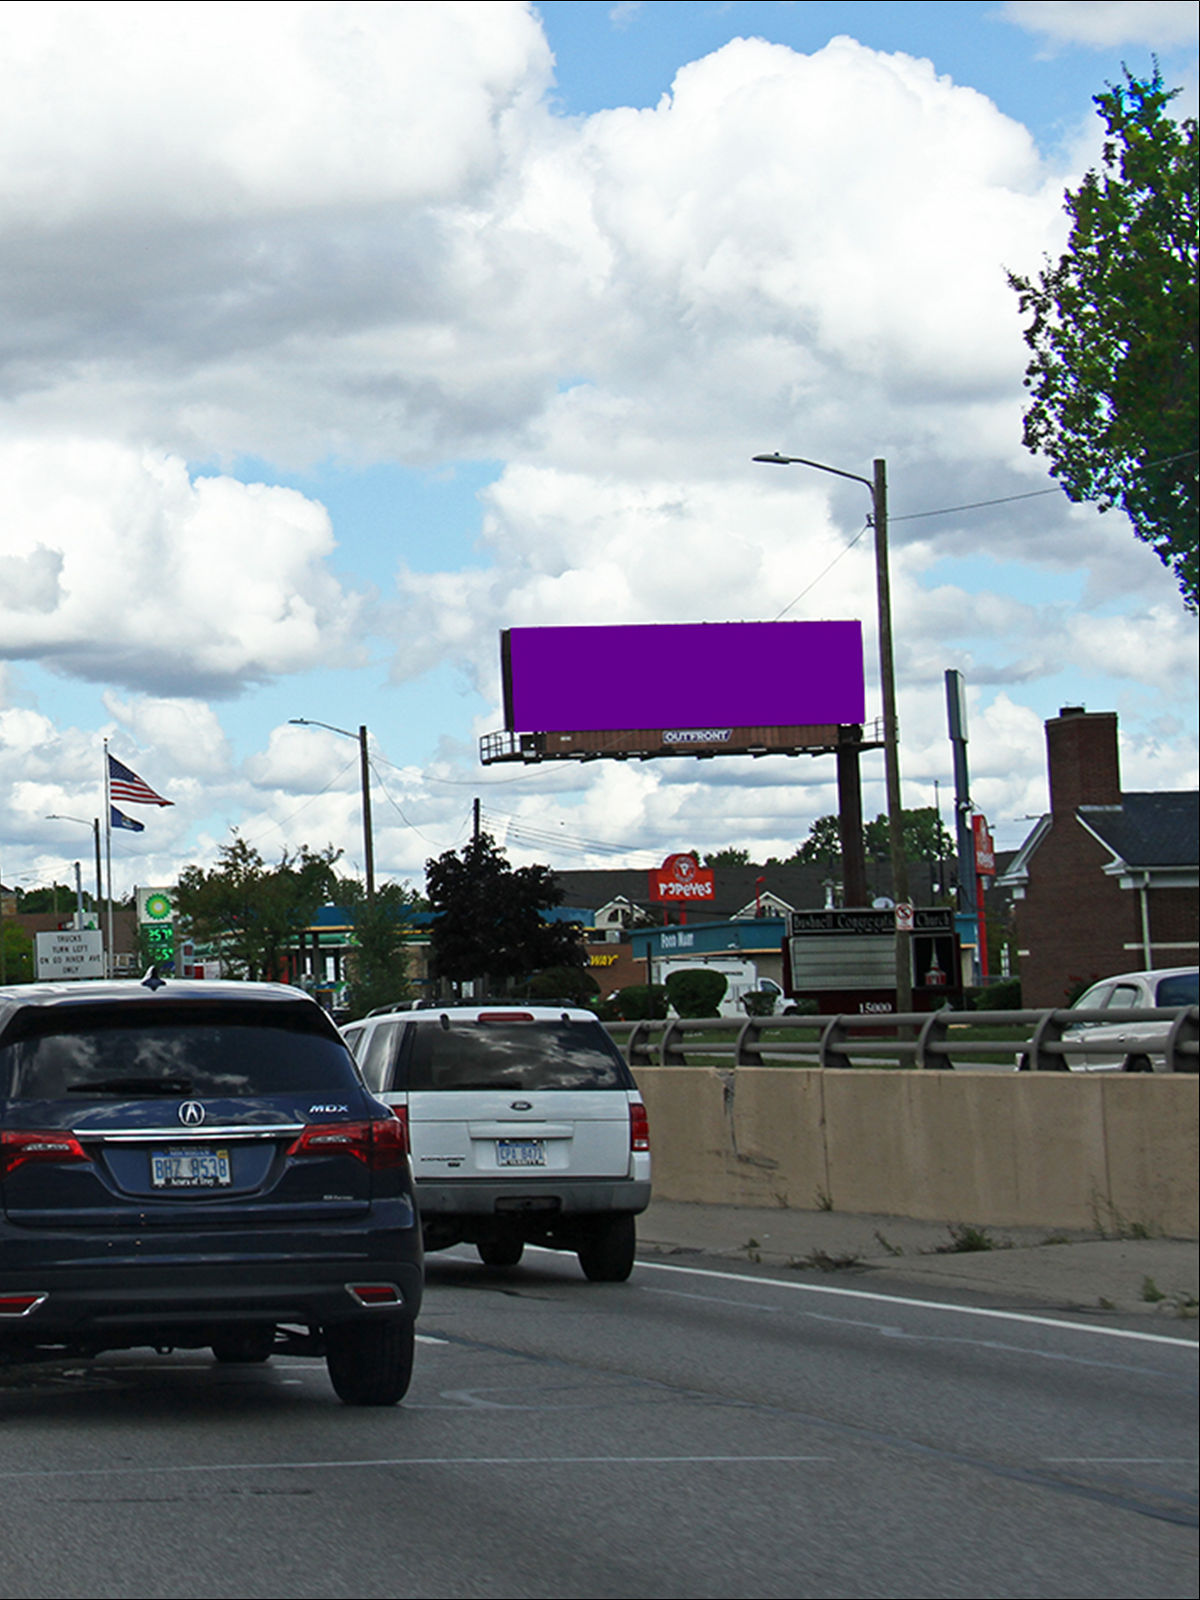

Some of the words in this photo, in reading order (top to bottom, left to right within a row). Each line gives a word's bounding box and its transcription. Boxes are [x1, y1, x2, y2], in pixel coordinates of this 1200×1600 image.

[665, 731, 730, 742] OUTFRONT
[659, 882, 713, 897] POPEYES
[916, 912, 950, 927] Church
[57, 934, 82, 942] TRUCKS
[73, 945, 88, 953] LEFT
[62, 966, 79, 974] ONLY
[859, 1002, 892, 1014] 15000
[309, 1104, 349, 1113] MDX
